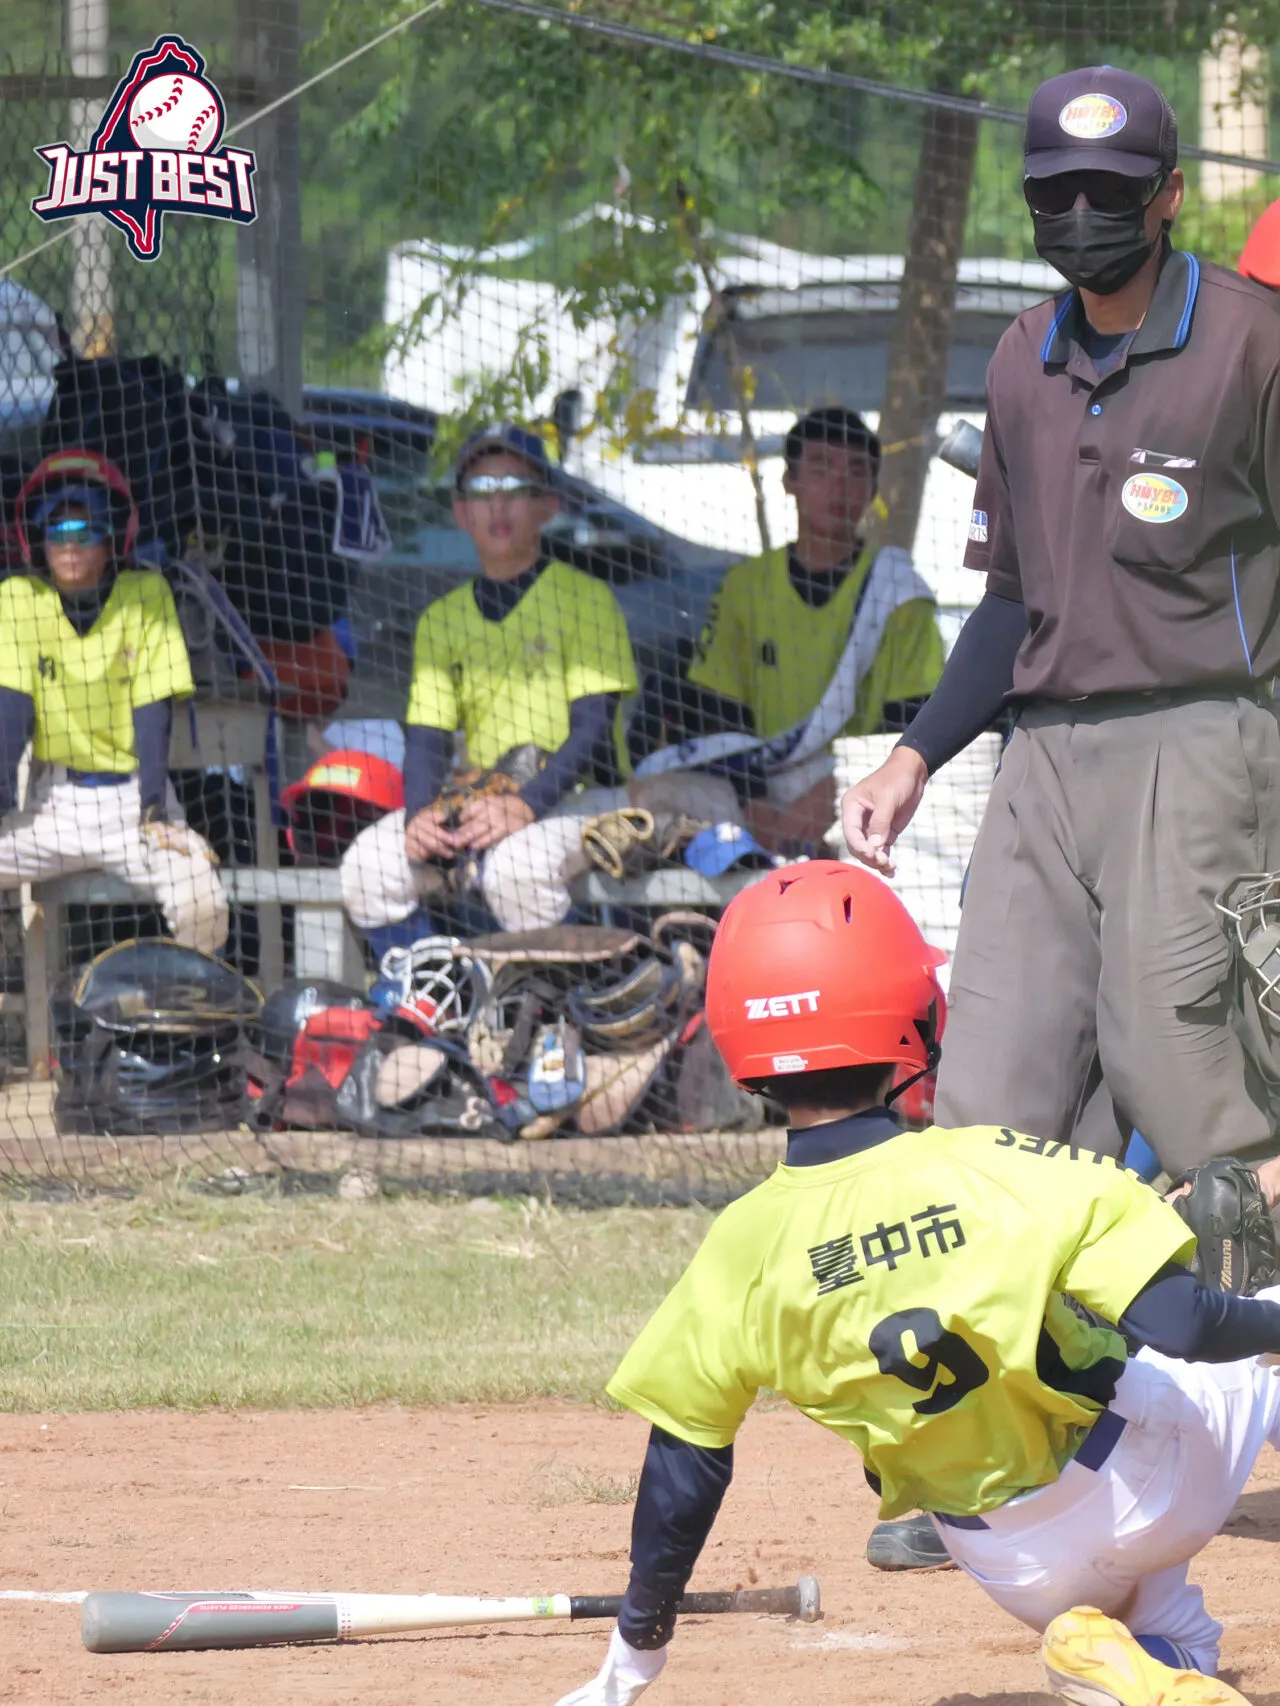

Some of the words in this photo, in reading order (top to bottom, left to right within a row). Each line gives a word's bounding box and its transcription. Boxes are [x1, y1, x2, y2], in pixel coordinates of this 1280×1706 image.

[744, 989, 821, 1020] ZETT
[807, 1203, 967, 1297] 臺中市
[868, 1306, 990, 1415] 9
